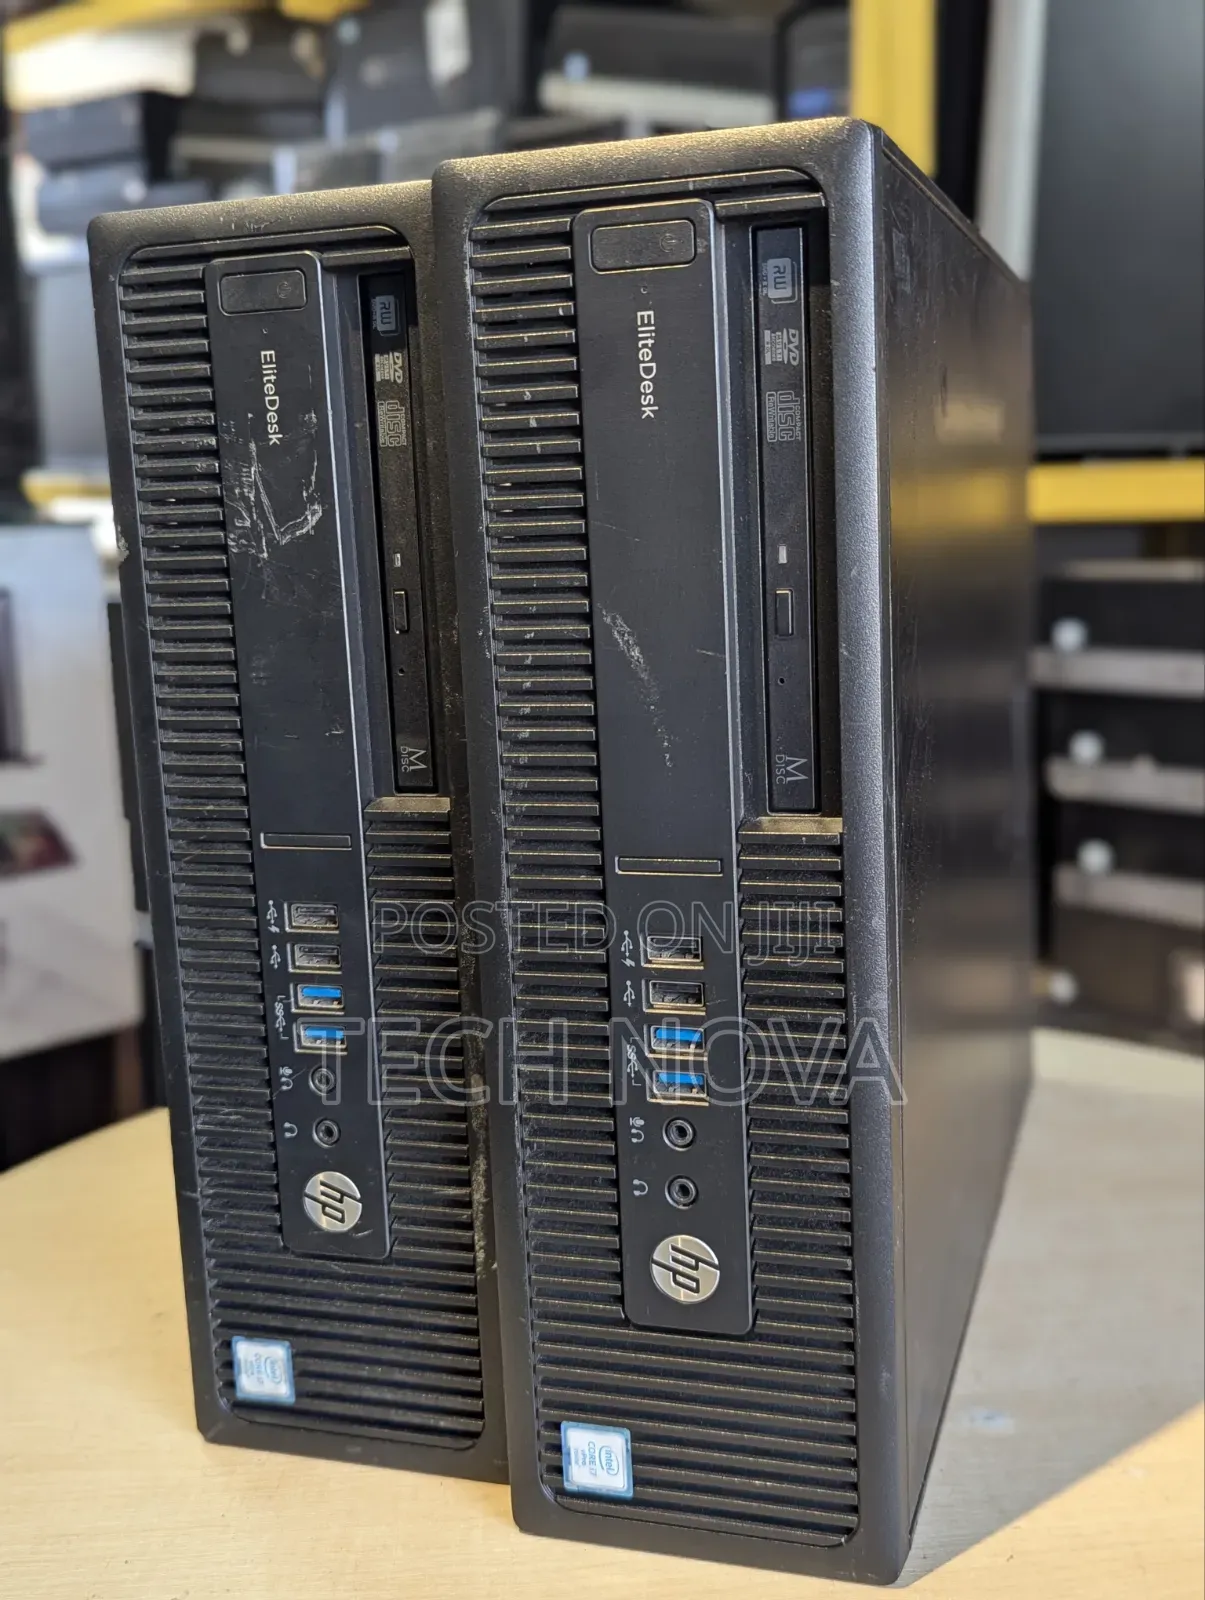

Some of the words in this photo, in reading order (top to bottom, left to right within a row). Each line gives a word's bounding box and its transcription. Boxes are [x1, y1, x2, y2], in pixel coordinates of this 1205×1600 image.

[773, 264, 787, 290] RW
[379, 301, 393, 326] RW
[788, 328, 800, 366] DVD
[394, 352, 403, 384] DVD
[637, 310, 659, 419] EliteDesk
[261, 350, 284, 446] EliteDesk
[400, 746, 410, 772] DISC
[409, 747, 427, 772] M
[775, 754, 786, 784] DISC
[785, 754, 809, 784] M
[304, 1174, 362, 1229] hp
[650, 1238, 720, 1301] hp
[588, 1441, 597, 1466] CORE
[604, 1449, 616, 1471] intel
